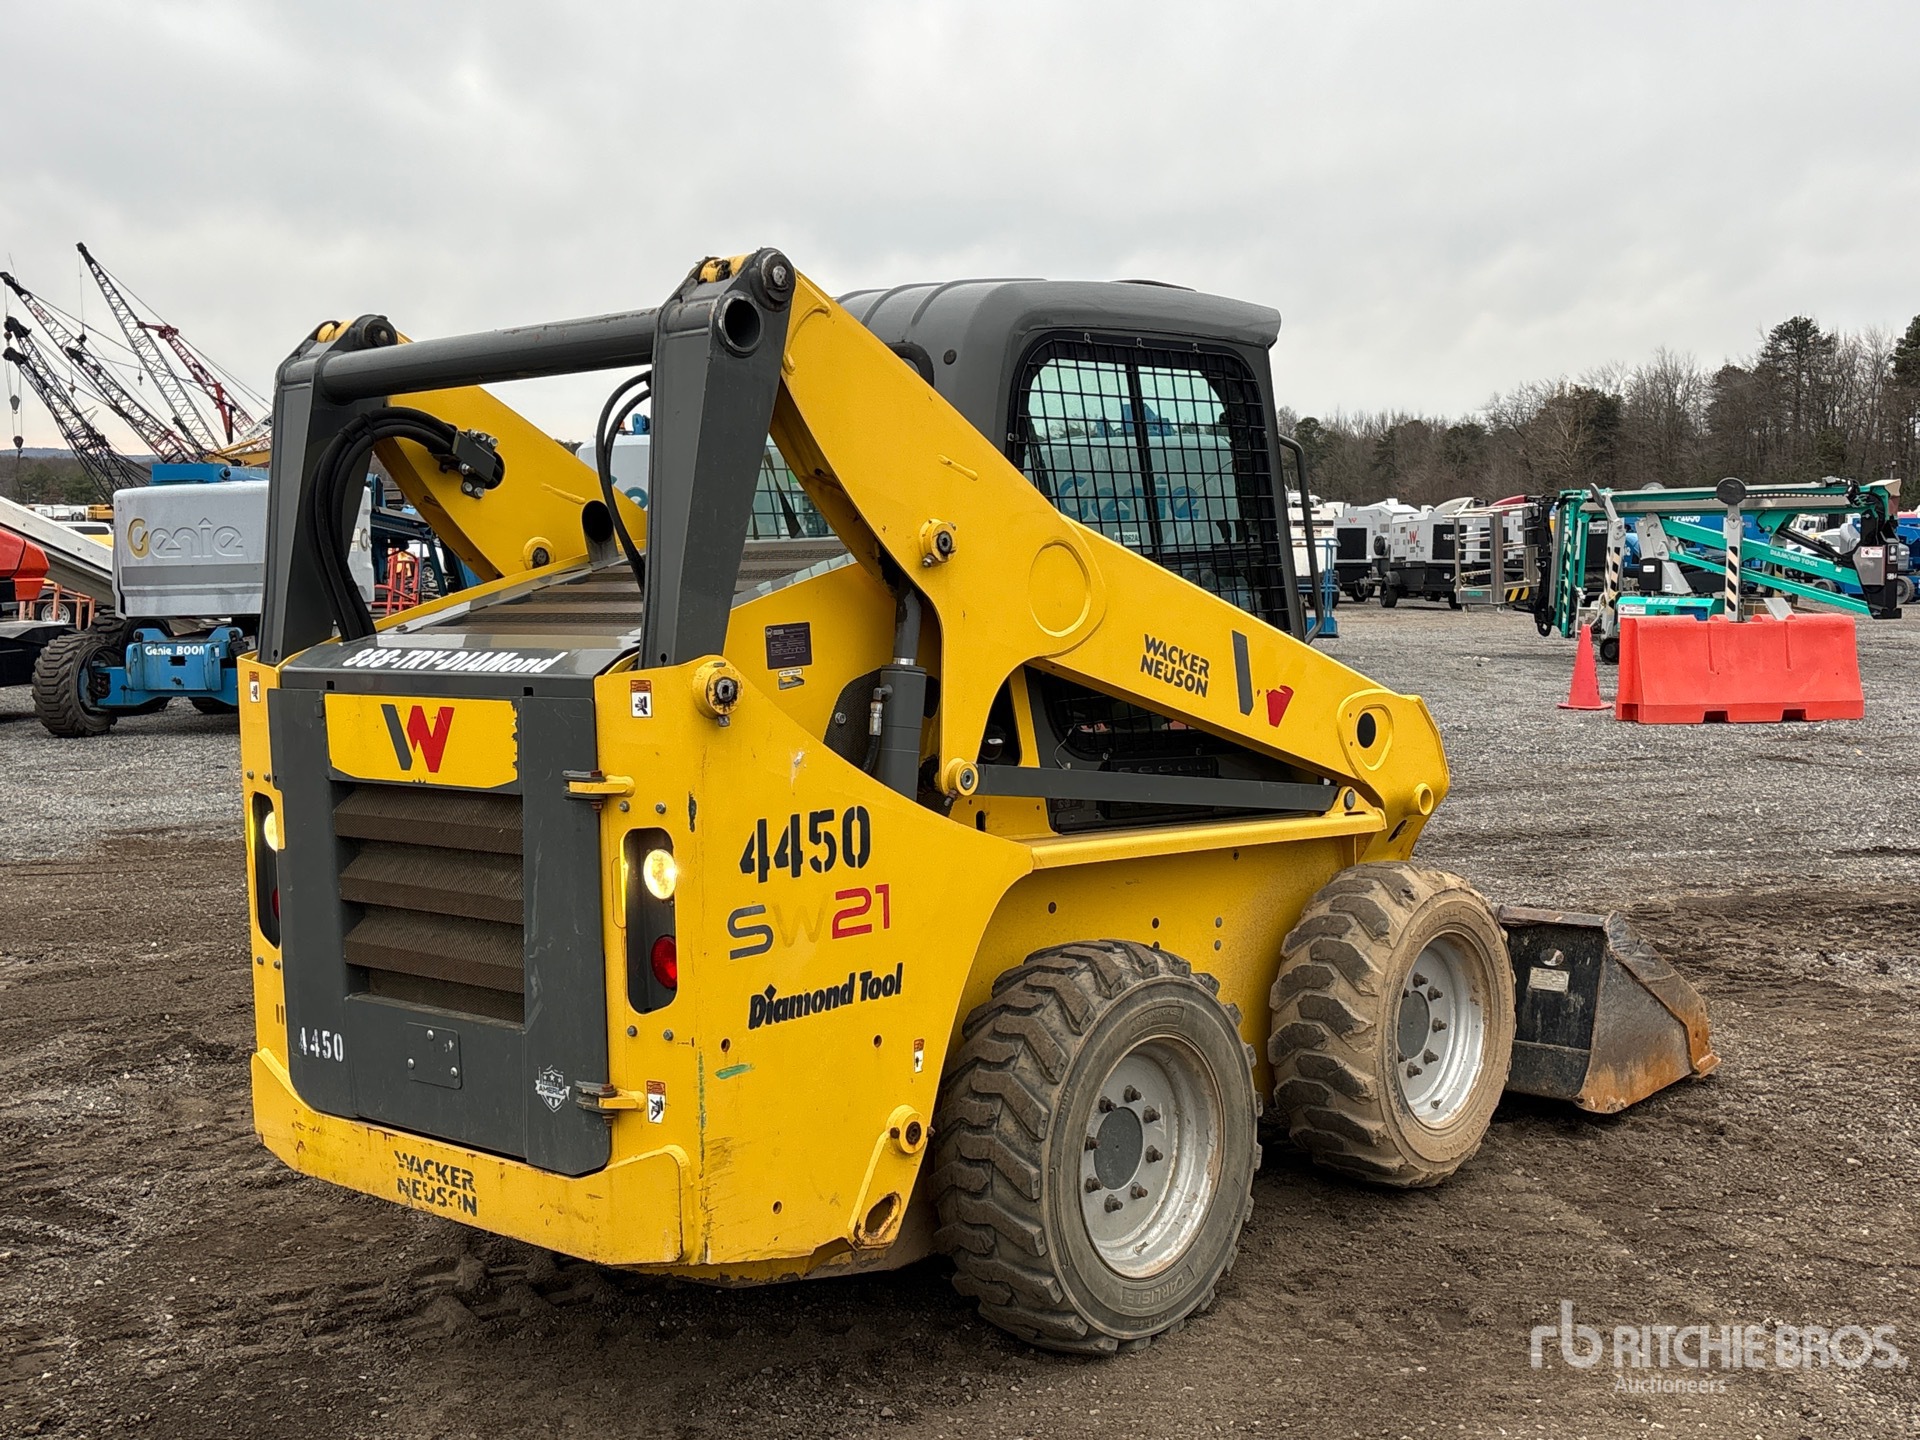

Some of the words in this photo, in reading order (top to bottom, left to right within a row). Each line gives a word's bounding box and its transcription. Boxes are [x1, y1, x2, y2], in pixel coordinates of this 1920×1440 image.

[1801, 557, 1818, 567] TOOL
[145, 646, 172, 656] Genie
[342, 648, 568, 673] 888-TRY-DIAMond
[1144, 633, 1210, 679] WACKER
[1140, 655, 1208, 698] NEUSON
[739, 805, 871, 884] 4450
[748, 972, 855, 1030] Diamond
[859, 961, 904, 1002] Tool
[299, 1027, 344, 1062] 4450
[394, 1150, 476, 1194] WACKER
[396, 1177, 478, 1217] NEUSON
